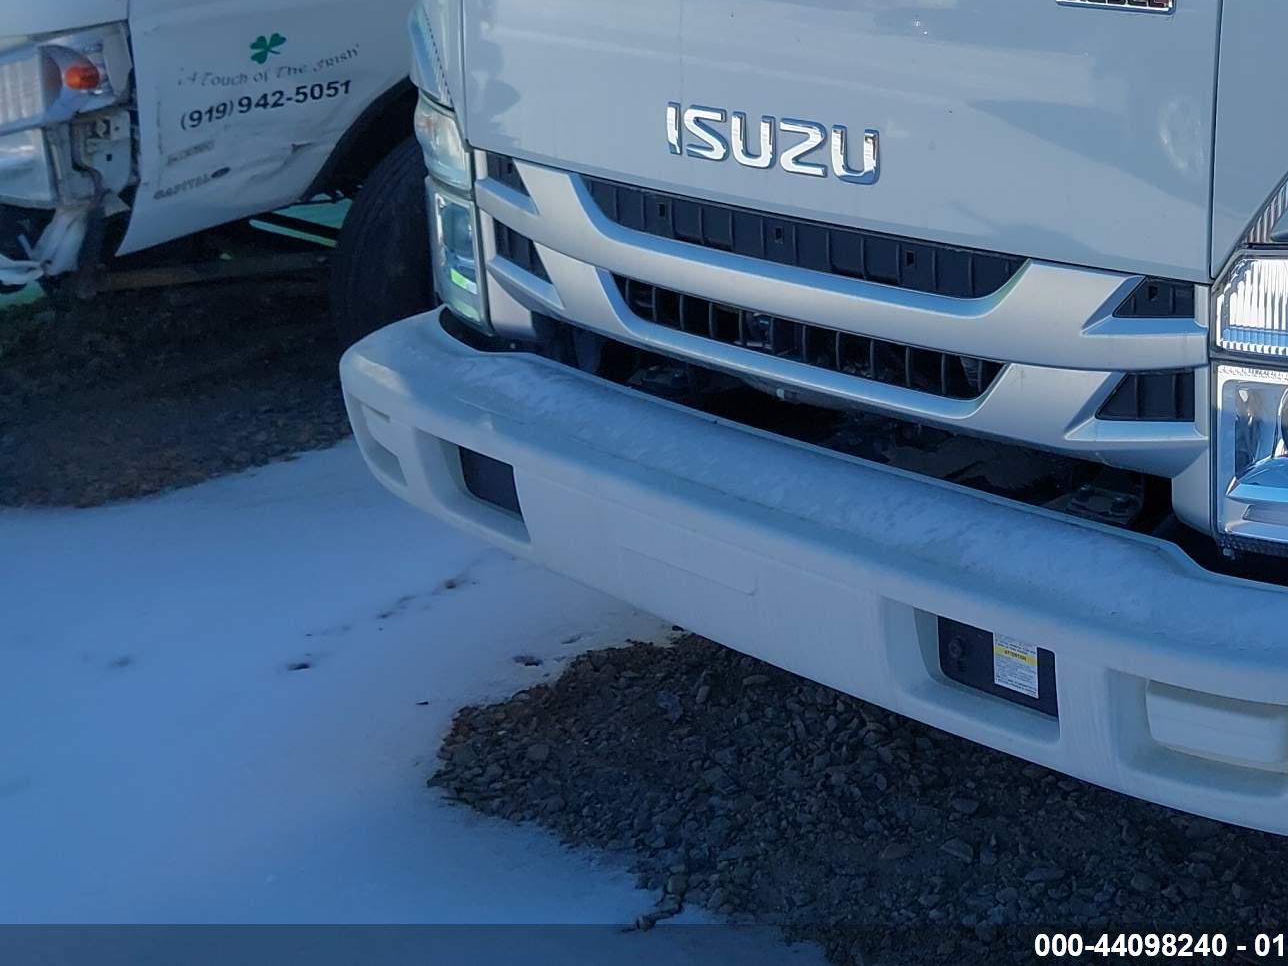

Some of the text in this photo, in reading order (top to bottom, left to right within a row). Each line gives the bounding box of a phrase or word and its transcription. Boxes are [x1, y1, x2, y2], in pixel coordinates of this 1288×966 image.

[201, 71, 248, 87] Touch
[276, 64, 310, 79] The
[665, 101, 881, 186] ISUZU
